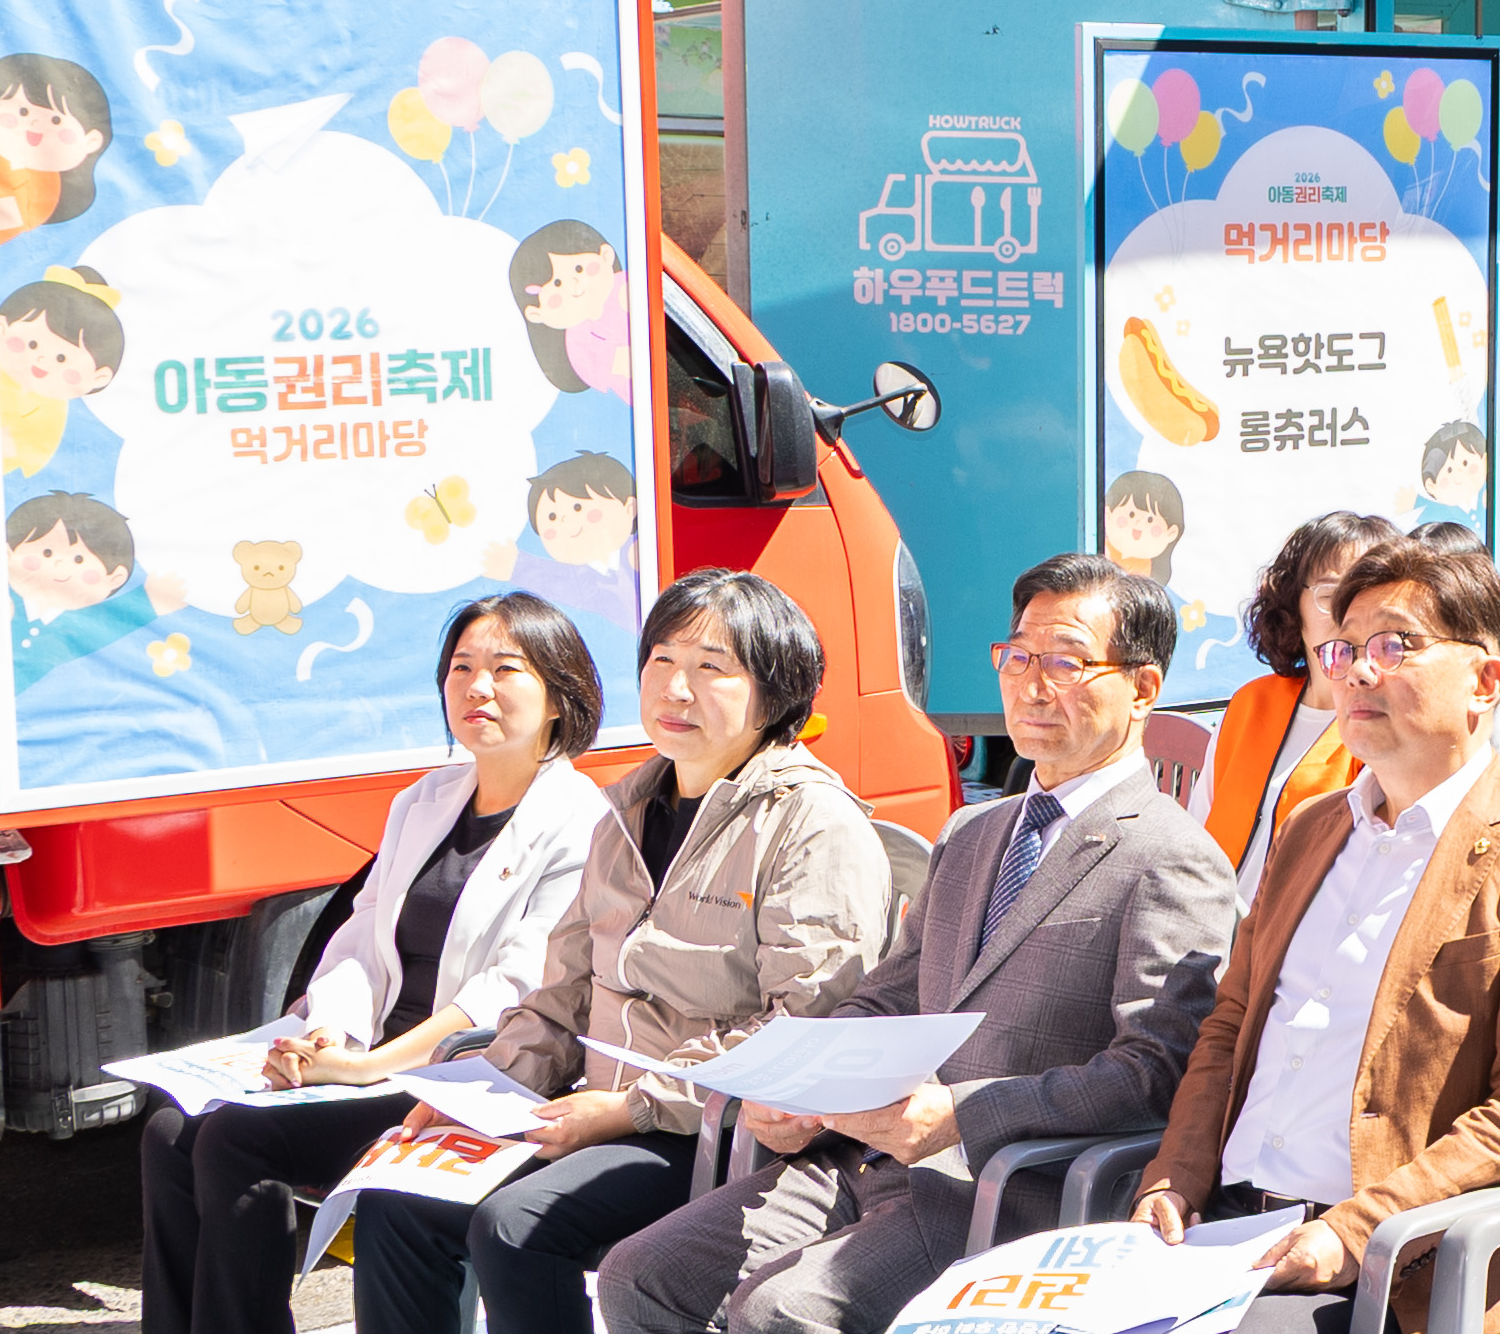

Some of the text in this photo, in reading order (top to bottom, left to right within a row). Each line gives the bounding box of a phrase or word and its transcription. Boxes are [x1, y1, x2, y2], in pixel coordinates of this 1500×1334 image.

[928, 115, 1022, 131] HOWTRUCK
[1266, 184, 1349, 205] 아동권리축제
[1294, 172, 1321, 183] 2026
[1223, 221, 1390, 265] 먹거리마당
[853, 267, 1064, 308] 하우푸드트럭
[271, 306, 381, 343] 2026
[889, 312, 1031, 336] 1800-5627
[1223, 331, 1388, 378] 뉴욕핫도그
[154, 347, 494, 415] 아동권리축제
[230, 418, 430, 466] 먹거리마당
[1239, 408, 1371, 453] 롱츄러스
